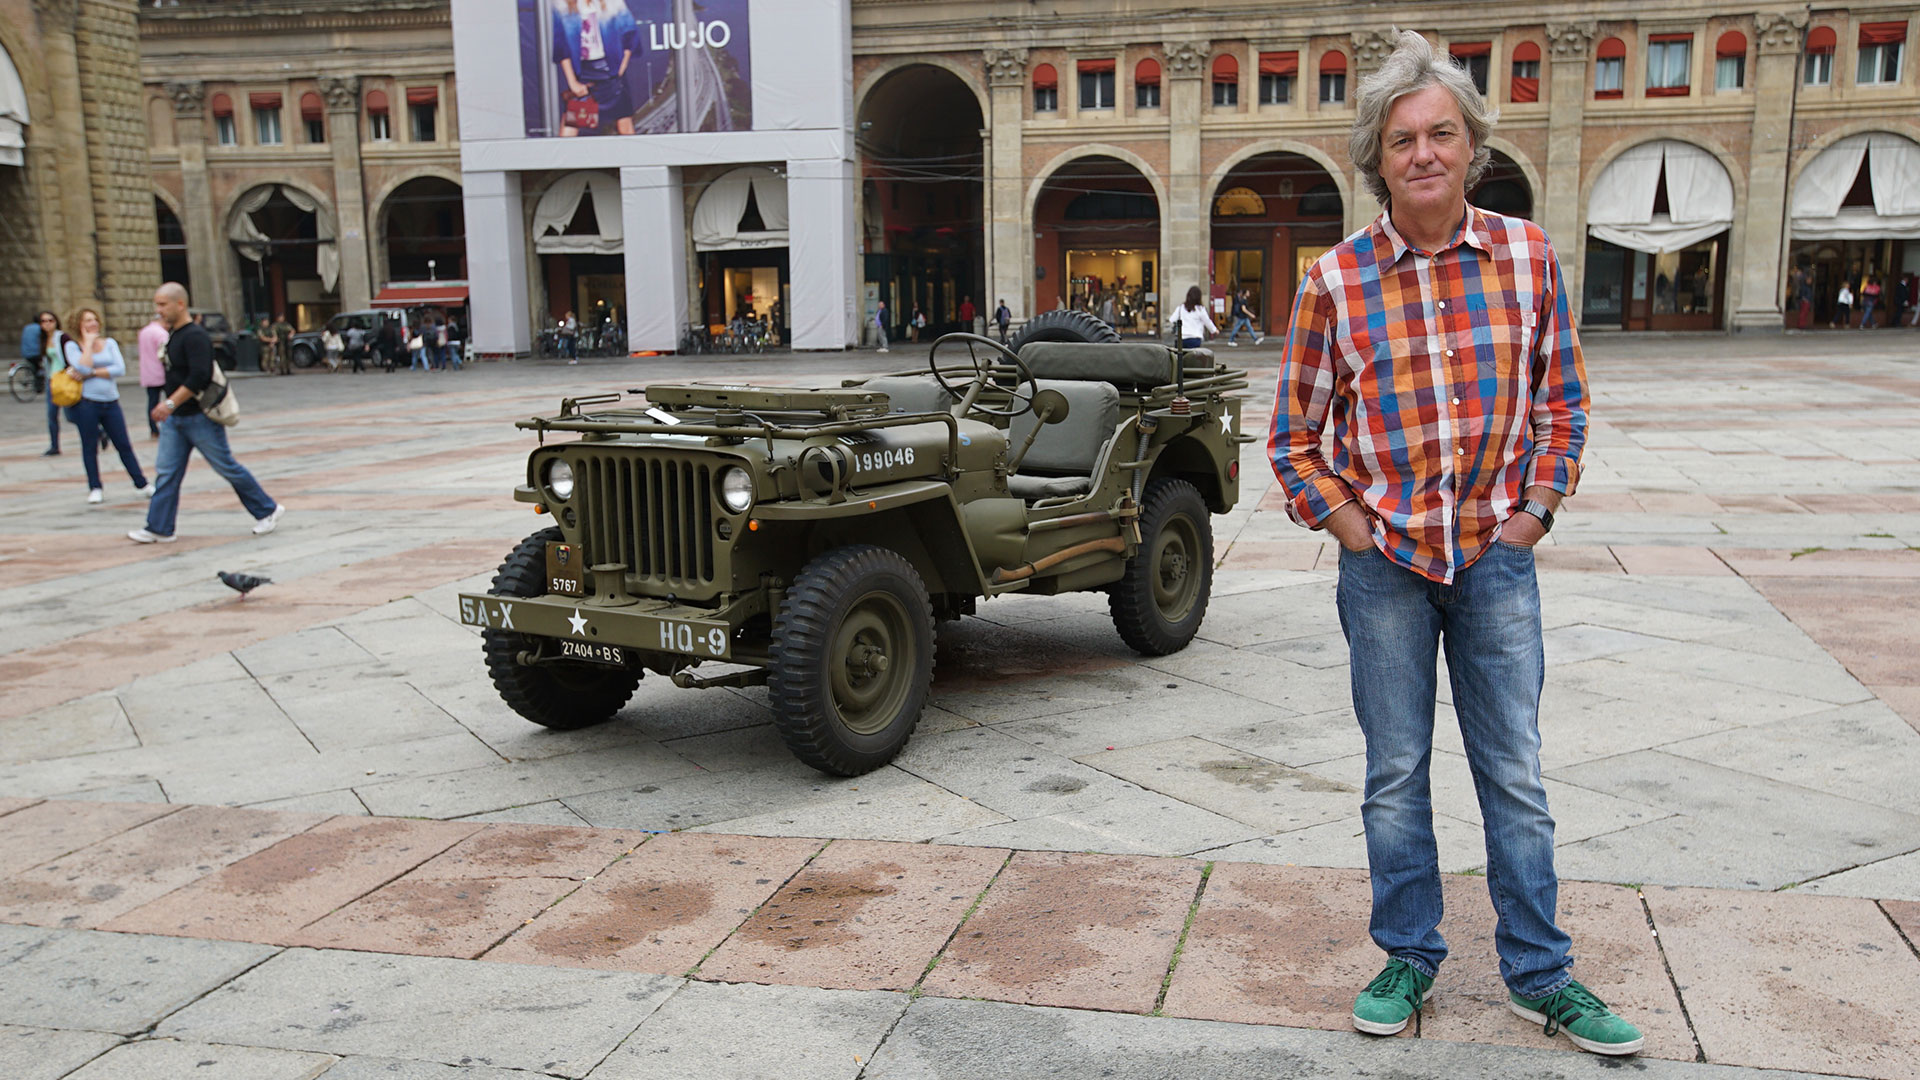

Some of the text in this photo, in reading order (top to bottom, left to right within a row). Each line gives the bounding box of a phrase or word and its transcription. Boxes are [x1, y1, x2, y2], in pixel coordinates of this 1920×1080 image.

[553, 578, 577, 592] 5767
[461, 597, 515, 630] 5A-X
[660, 620, 726, 656] HQ-9
